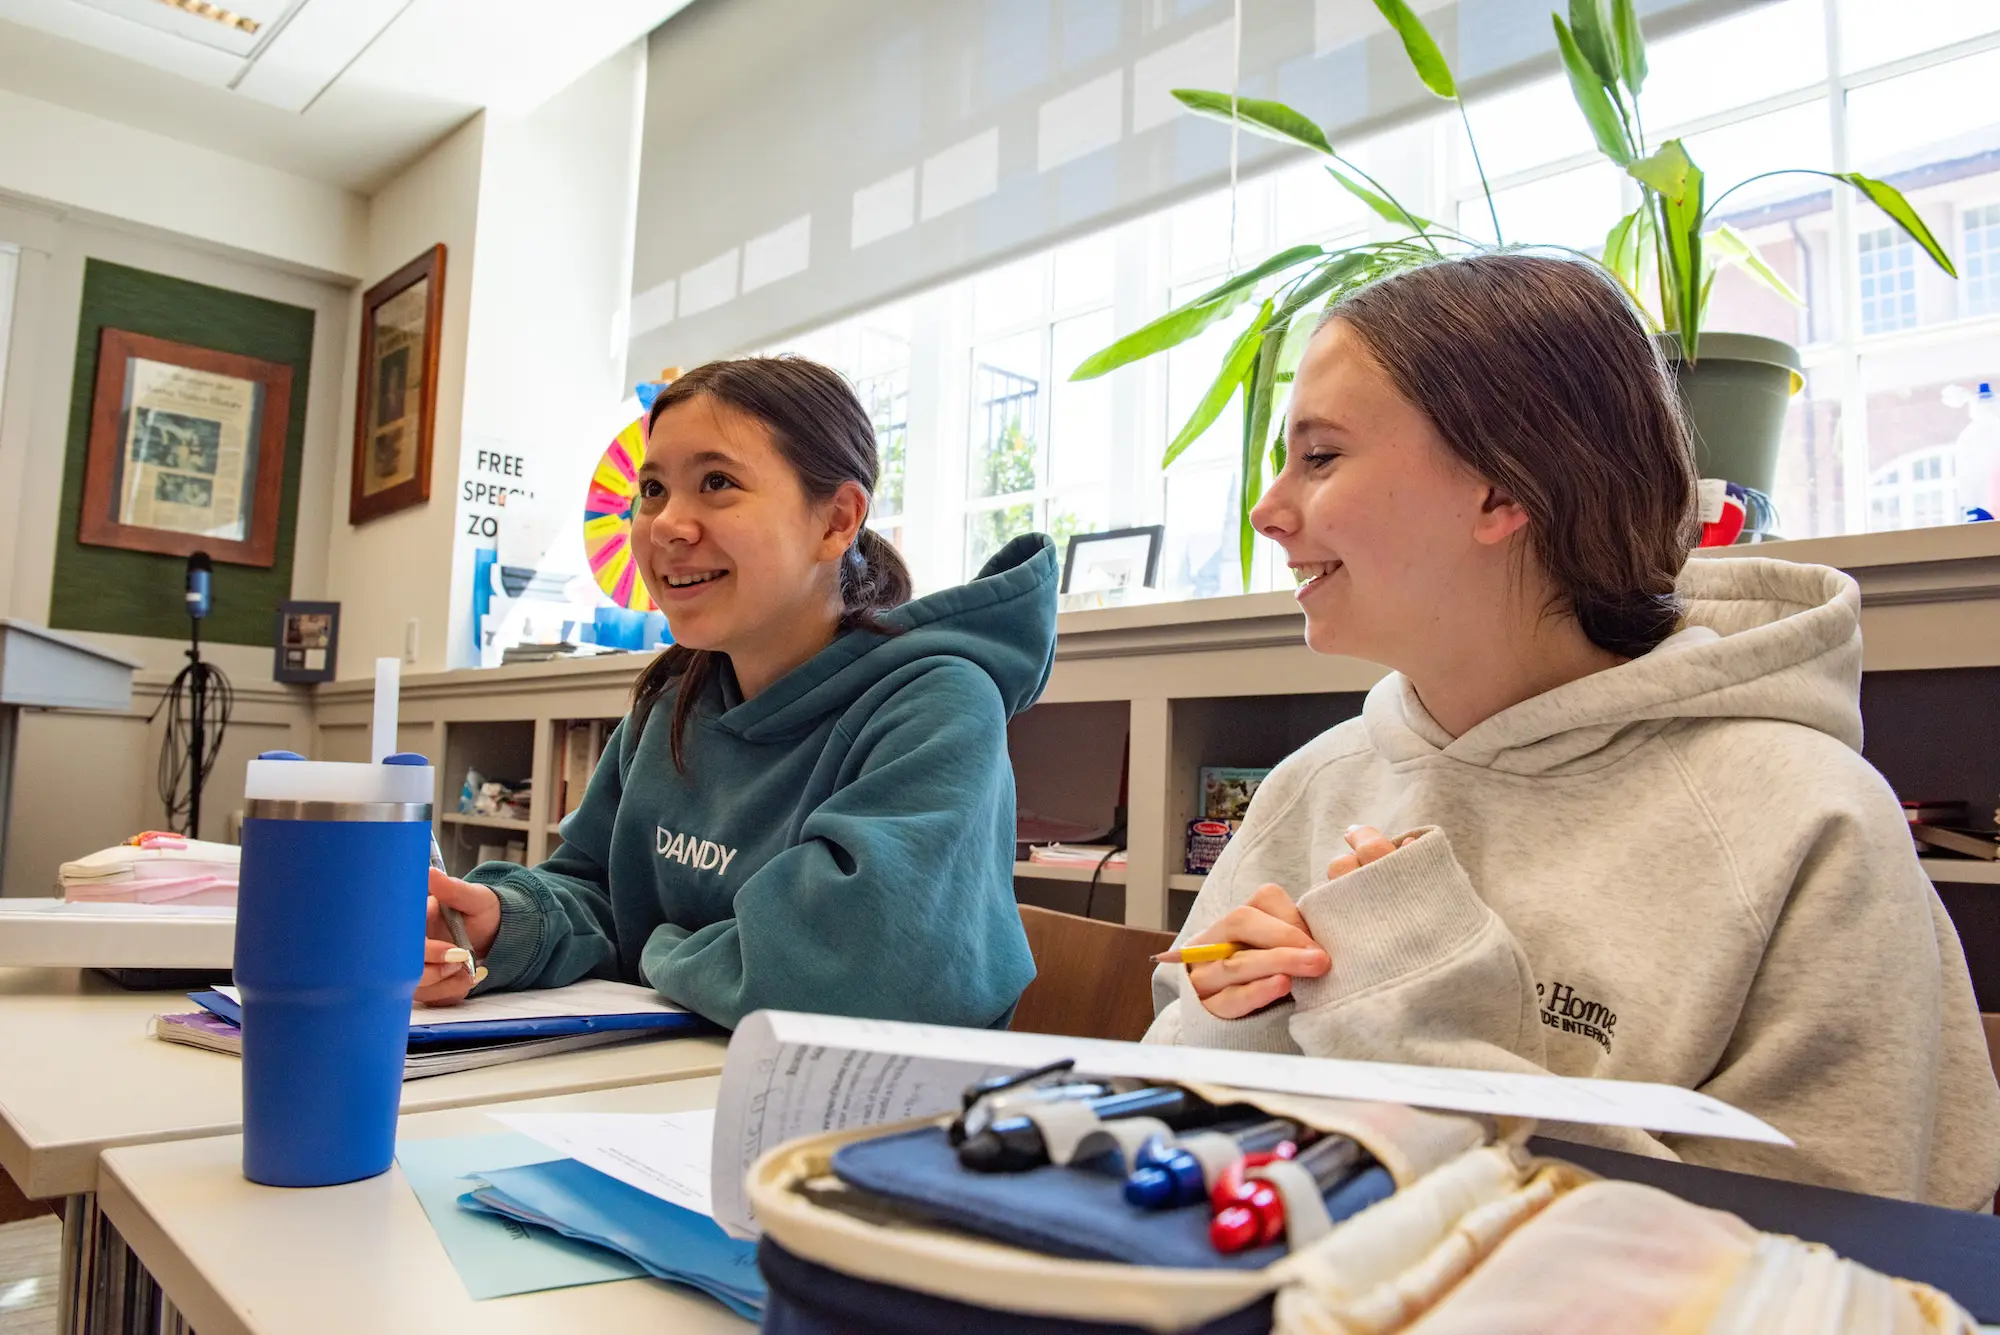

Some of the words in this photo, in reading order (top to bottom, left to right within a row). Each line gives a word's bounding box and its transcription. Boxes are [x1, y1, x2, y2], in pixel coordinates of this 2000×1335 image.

[477, 450, 524, 477] FREE
[463, 480, 534, 507] SPE
[656, 825, 738, 876] DANDY
[1547, 981, 1617, 1038] Home
